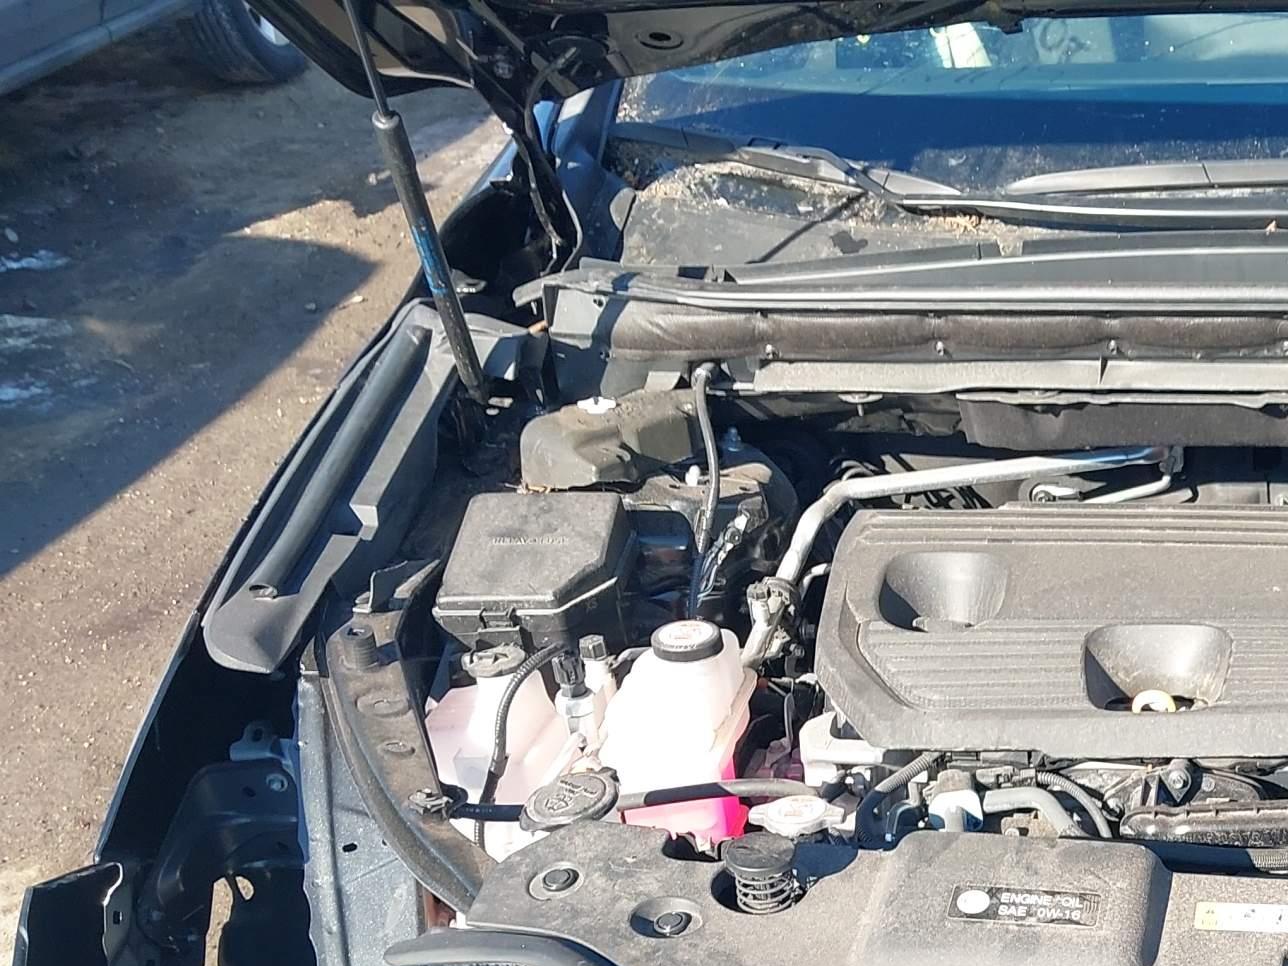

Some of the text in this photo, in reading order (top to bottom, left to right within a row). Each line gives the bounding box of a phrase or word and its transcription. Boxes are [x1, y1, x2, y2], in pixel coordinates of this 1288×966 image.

[1000, 892, 1084, 909] ENGINE OIL
[998, 904, 1082, 921] SAE 0W-16
